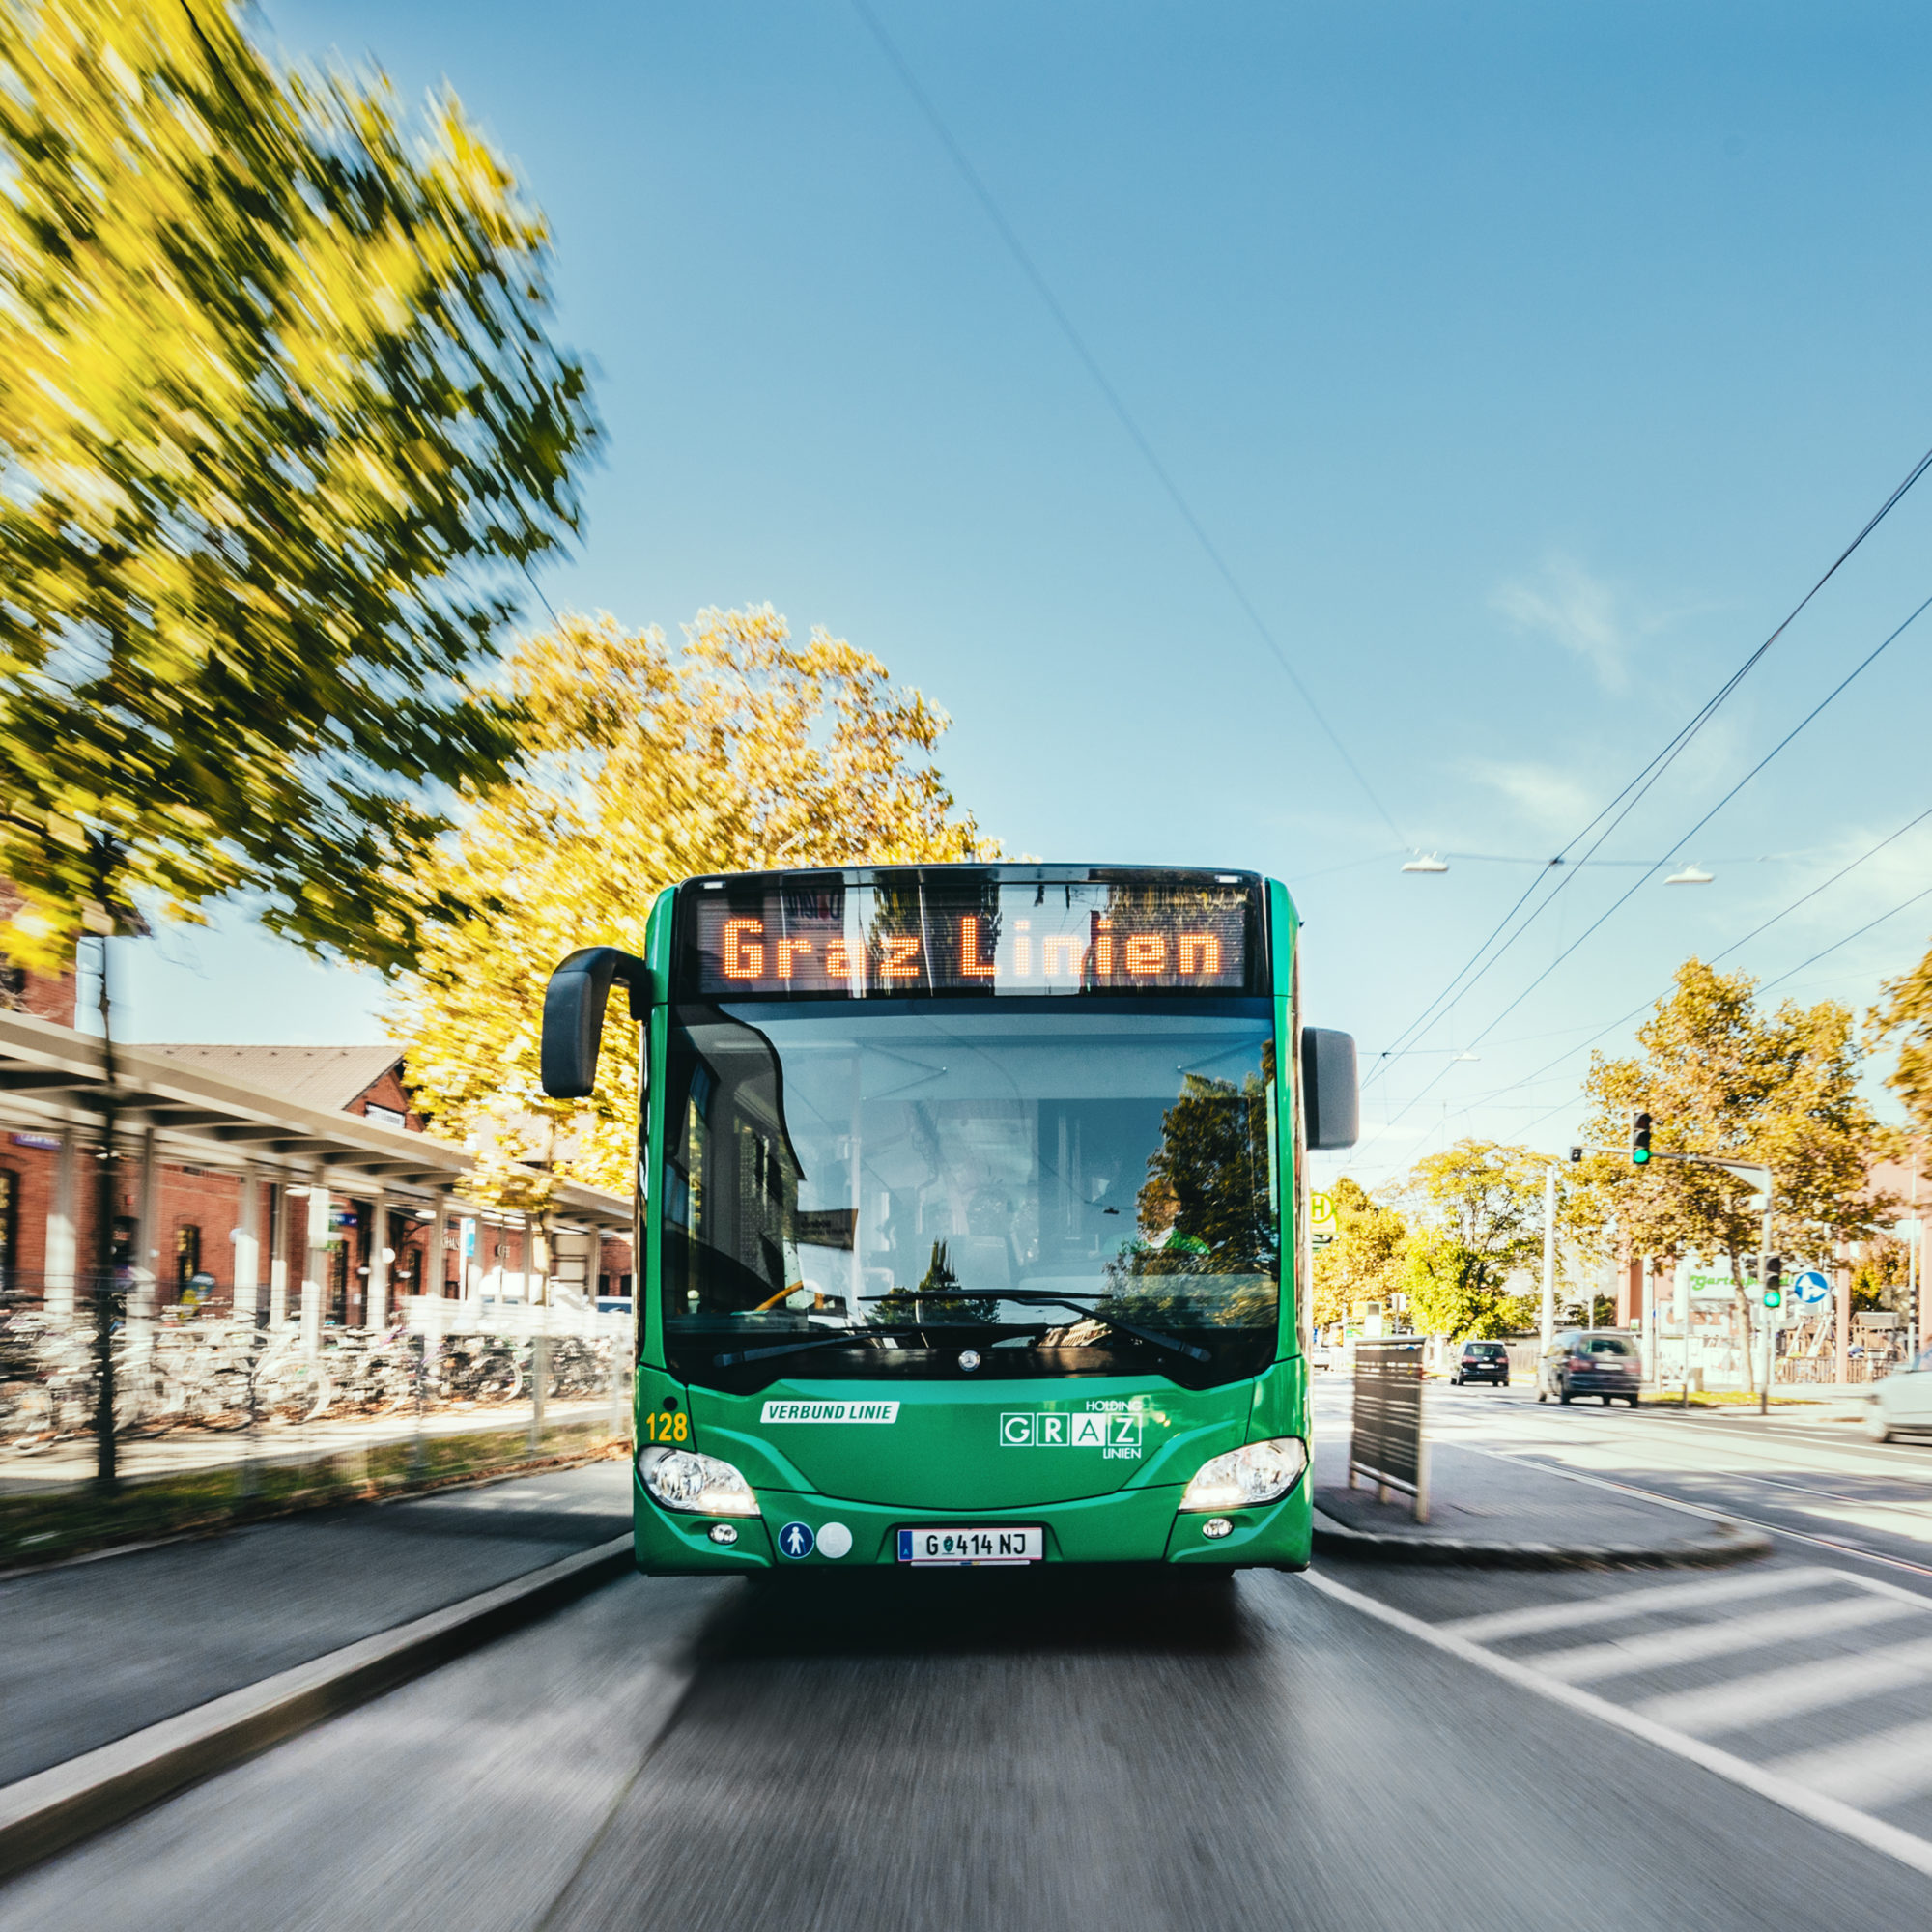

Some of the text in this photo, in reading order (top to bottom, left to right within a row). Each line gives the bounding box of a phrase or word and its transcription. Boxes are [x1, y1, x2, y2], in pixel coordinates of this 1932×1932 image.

[724, 916, 1220, 979] Graz Linien
[1312, 1197, 1325, 1218] H
[769, 1405, 893, 1420] VERBUND LINIE
[1085, 1400, 1143, 1412] HOLDING
[645, 1411, 689, 1442] 128
[1003, 1416, 1136, 1444] GRAZ
[1102, 1447, 1142, 1460] LINIEN
[999, 1533, 1026, 1555] NJ
